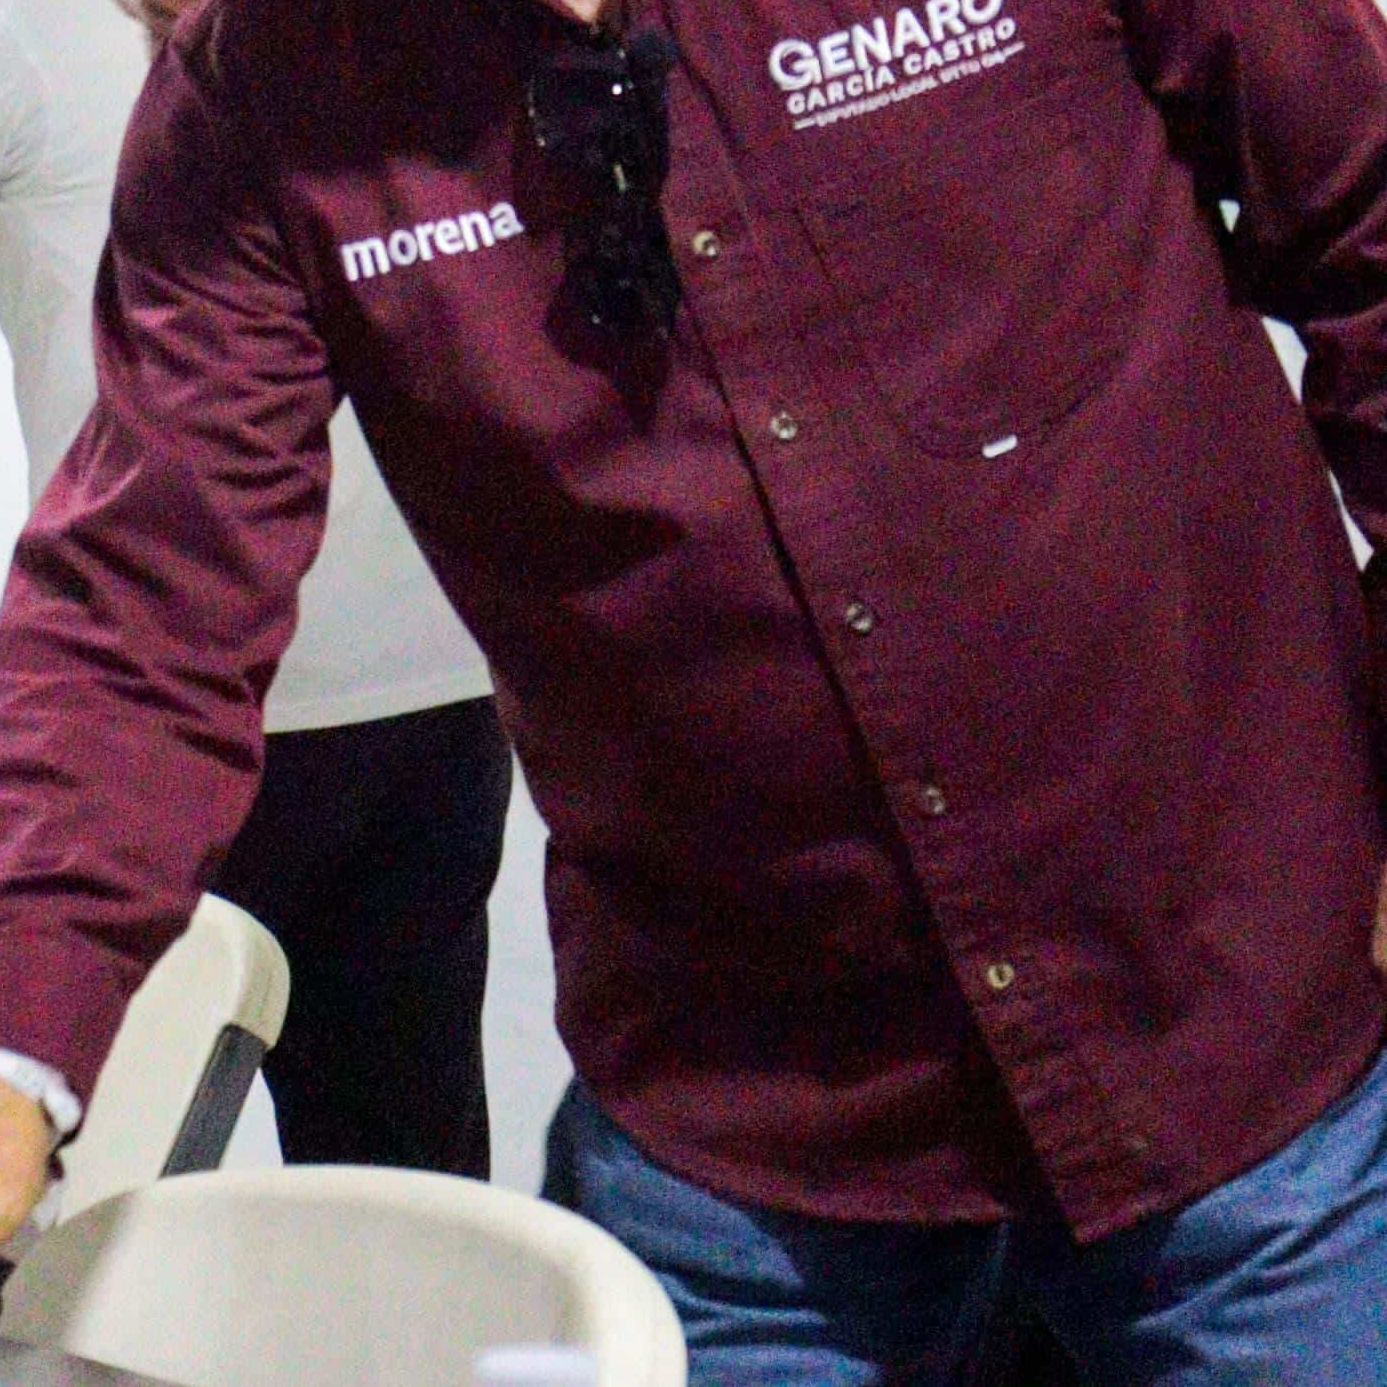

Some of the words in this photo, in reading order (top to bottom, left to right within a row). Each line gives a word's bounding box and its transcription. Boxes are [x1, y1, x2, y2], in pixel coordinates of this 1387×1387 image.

[786, 66, 896, 115] GARCÍA
[902, 17, 1017, 76] CASTRO
[341, 201, 525, 283] morena
